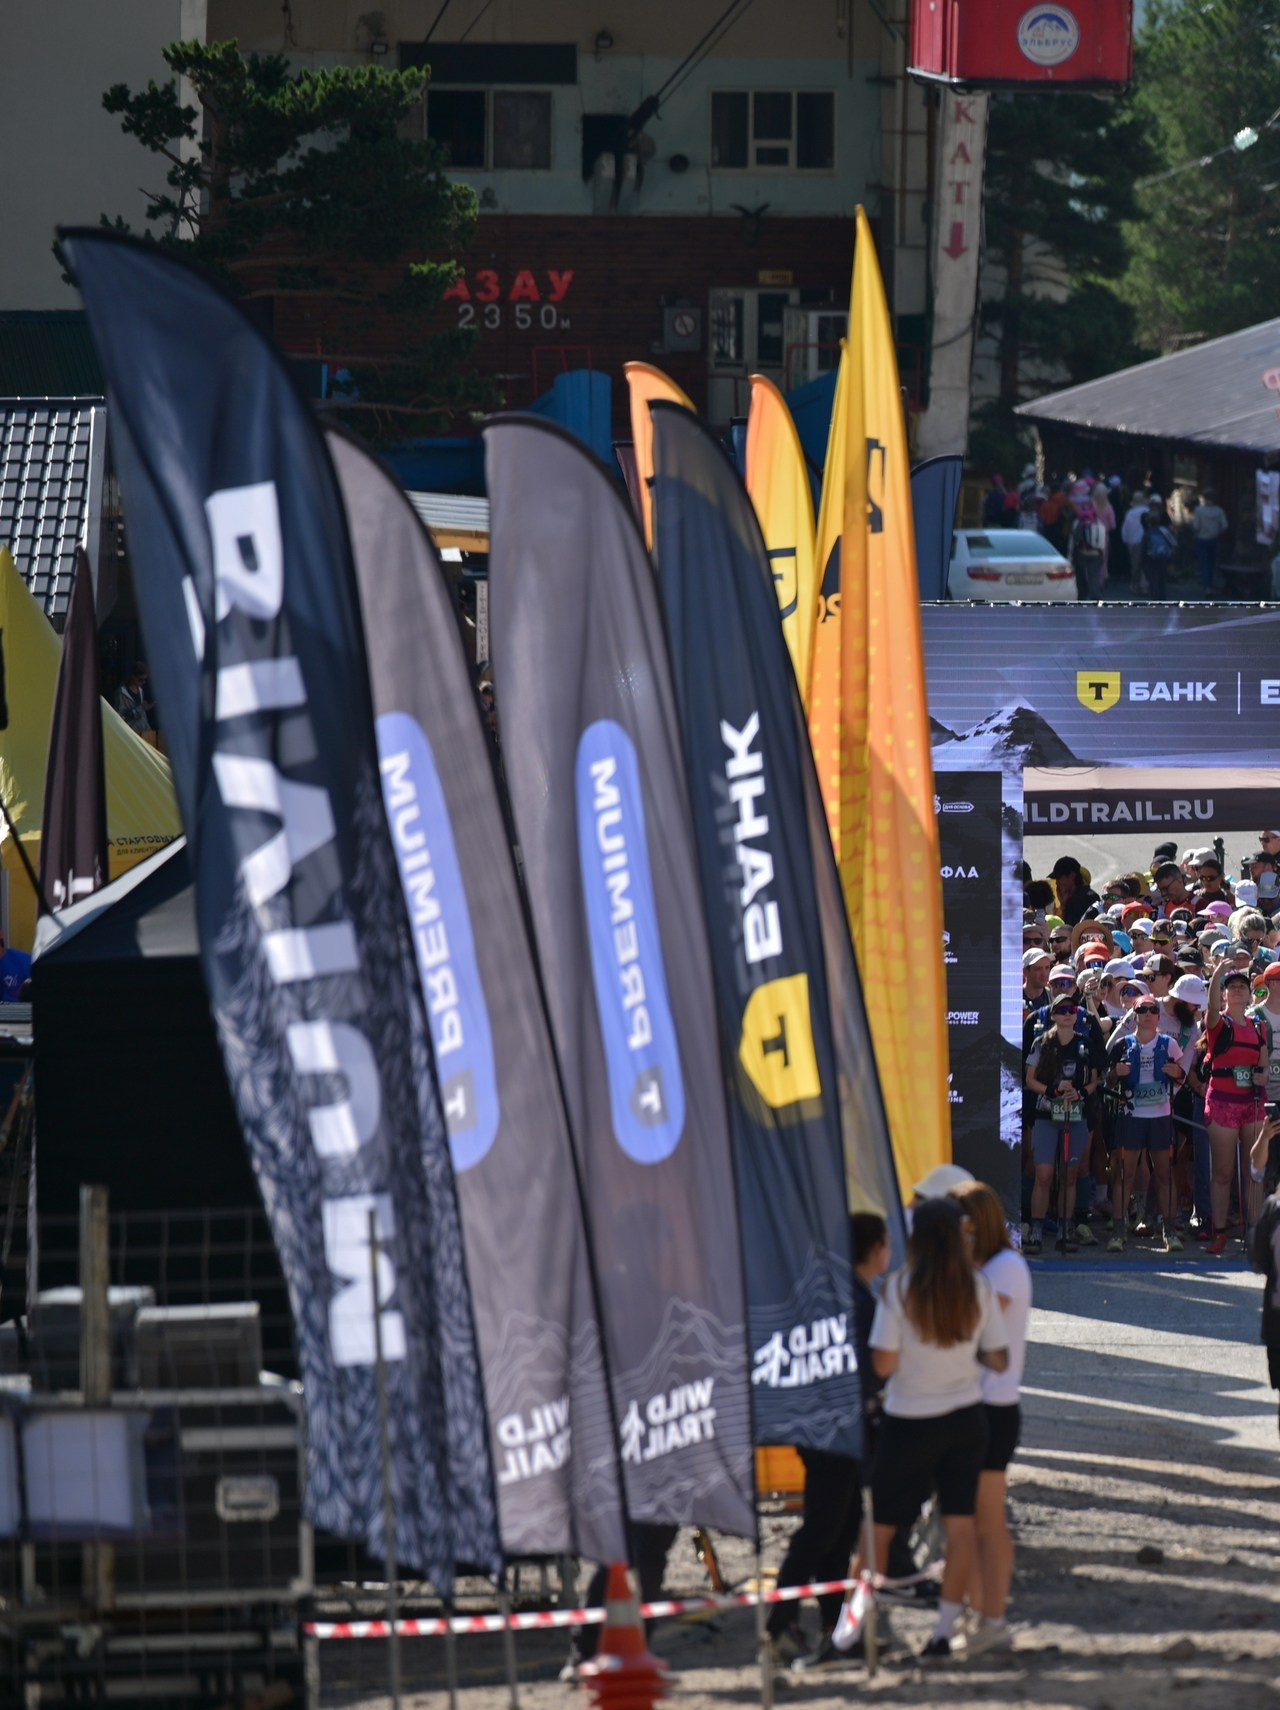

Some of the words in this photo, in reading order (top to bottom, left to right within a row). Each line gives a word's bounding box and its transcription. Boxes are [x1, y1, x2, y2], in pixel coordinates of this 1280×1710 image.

[1021, 38, 1073, 47] ЭЛЬБРУС
[1128, 681, 1217, 702] БАНК
[1023, 799, 1215, 824] ILDTRAIL.RU
[940, 865, 980, 879] ФЛА
